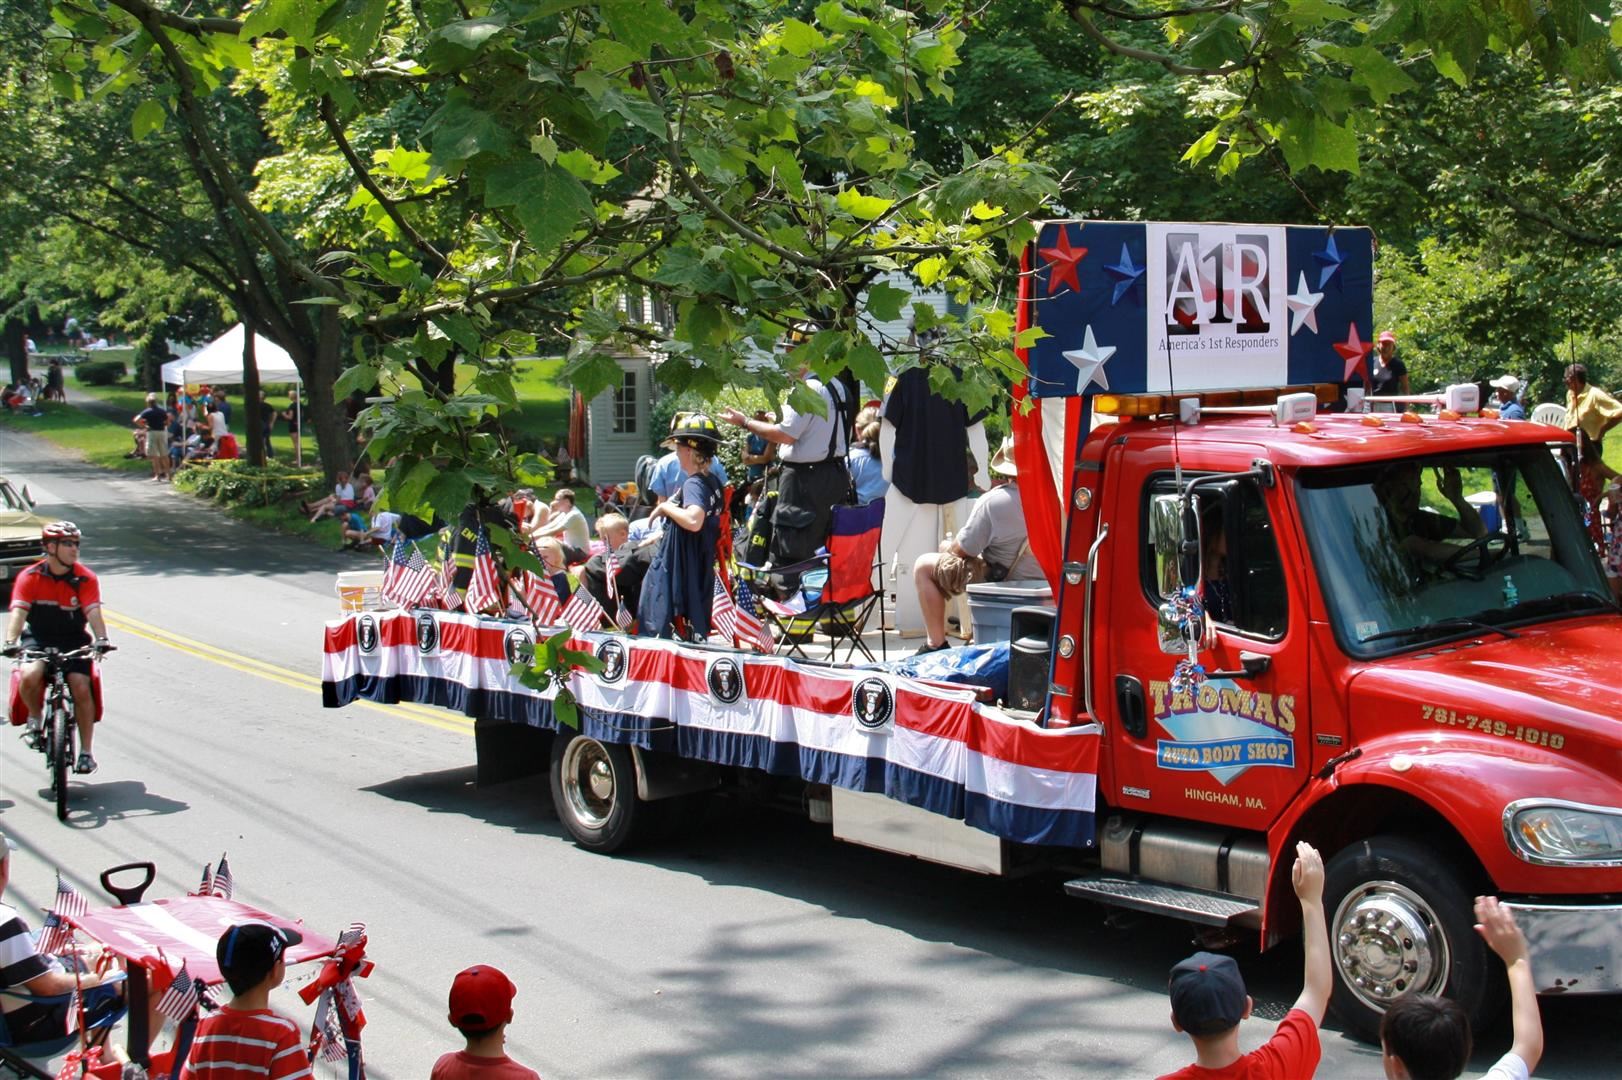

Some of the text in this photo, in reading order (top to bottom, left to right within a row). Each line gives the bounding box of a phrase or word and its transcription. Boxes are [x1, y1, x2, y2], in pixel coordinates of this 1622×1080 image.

[1159, 336, 1279, 351] America's 1st Responders
[1149, 680, 1296, 733] THOMAS
[1421, 704, 1565, 750] 781-749-1010
[1162, 742, 1289, 764] AUTO BODY SHOP
[1184, 788, 1267, 810] HINGHAM, MA.
